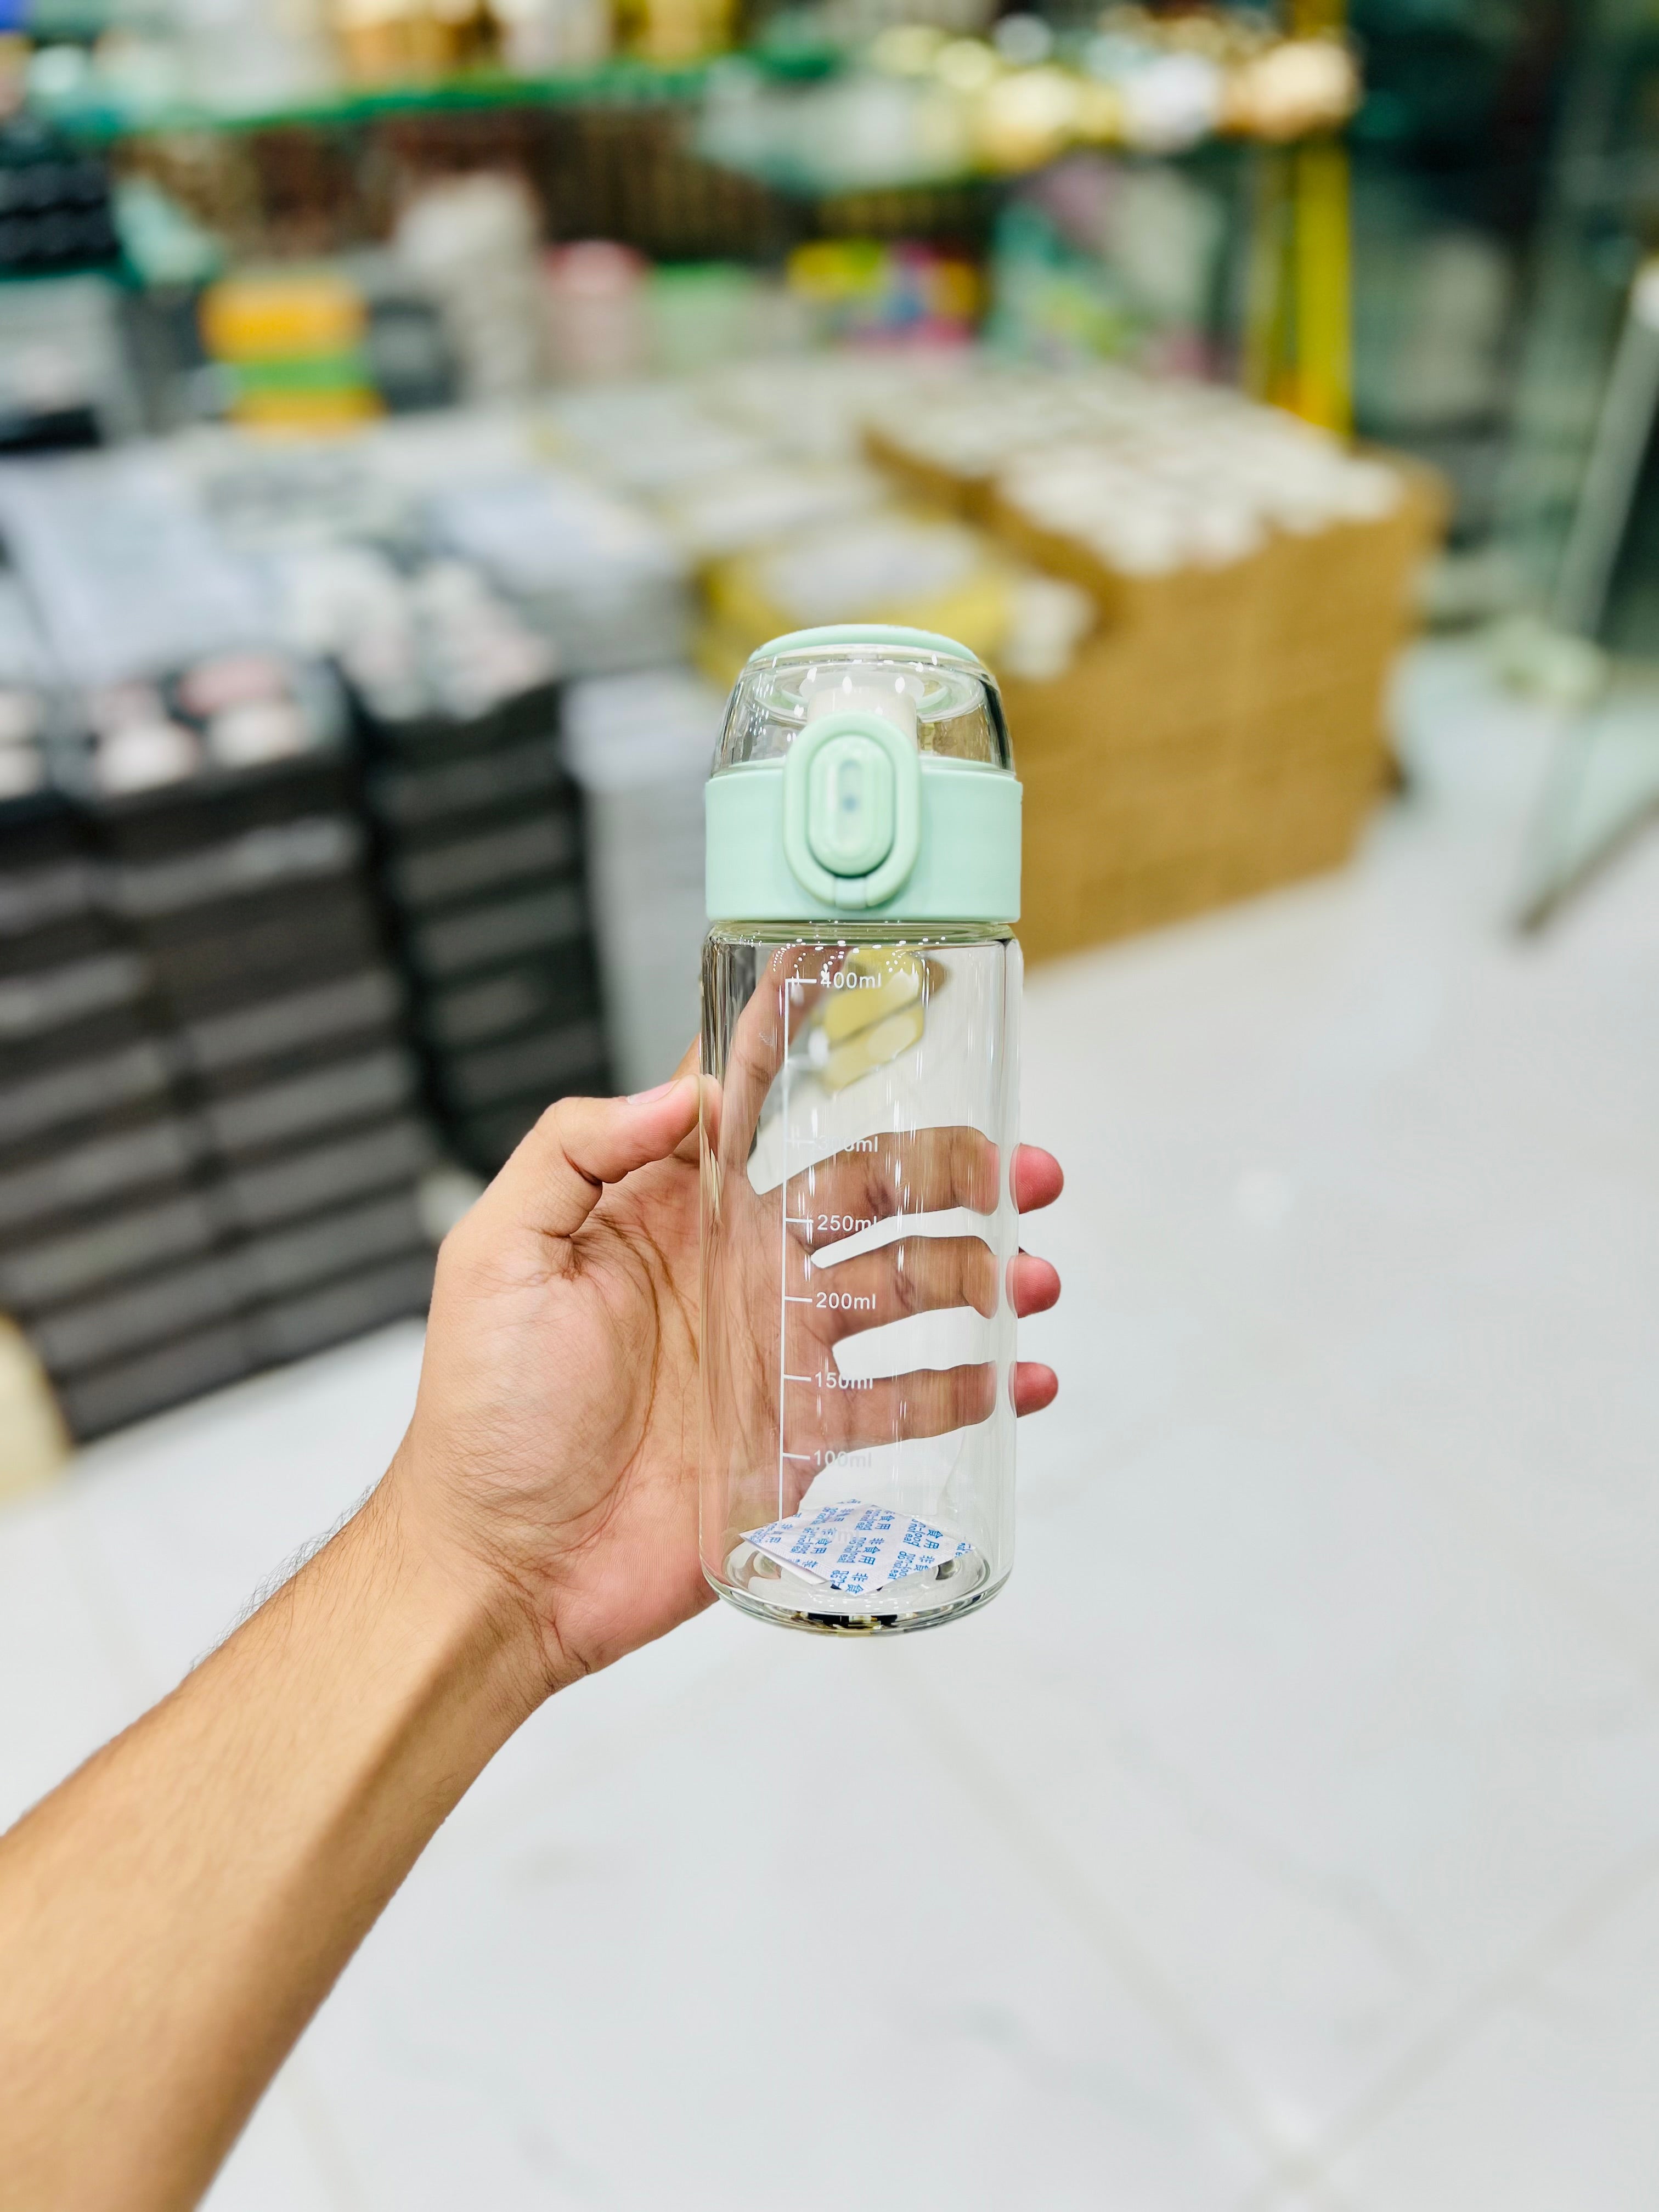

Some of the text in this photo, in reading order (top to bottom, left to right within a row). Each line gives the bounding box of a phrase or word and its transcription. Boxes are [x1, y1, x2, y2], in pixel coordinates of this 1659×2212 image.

[820, 970, 882, 989] 400ml
[817, 1215, 878, 1232] 250ml
[816, 1292, 876, 1310] 200ml
[815, 1373, 873, 1389] 150ml
[814, 1449, 872, 1468] 100ml
[847, 1537, 867, 1563] non-food
[858, 1538, 885, 1565] 非食用
[898, 1551, 907, 1559] do
